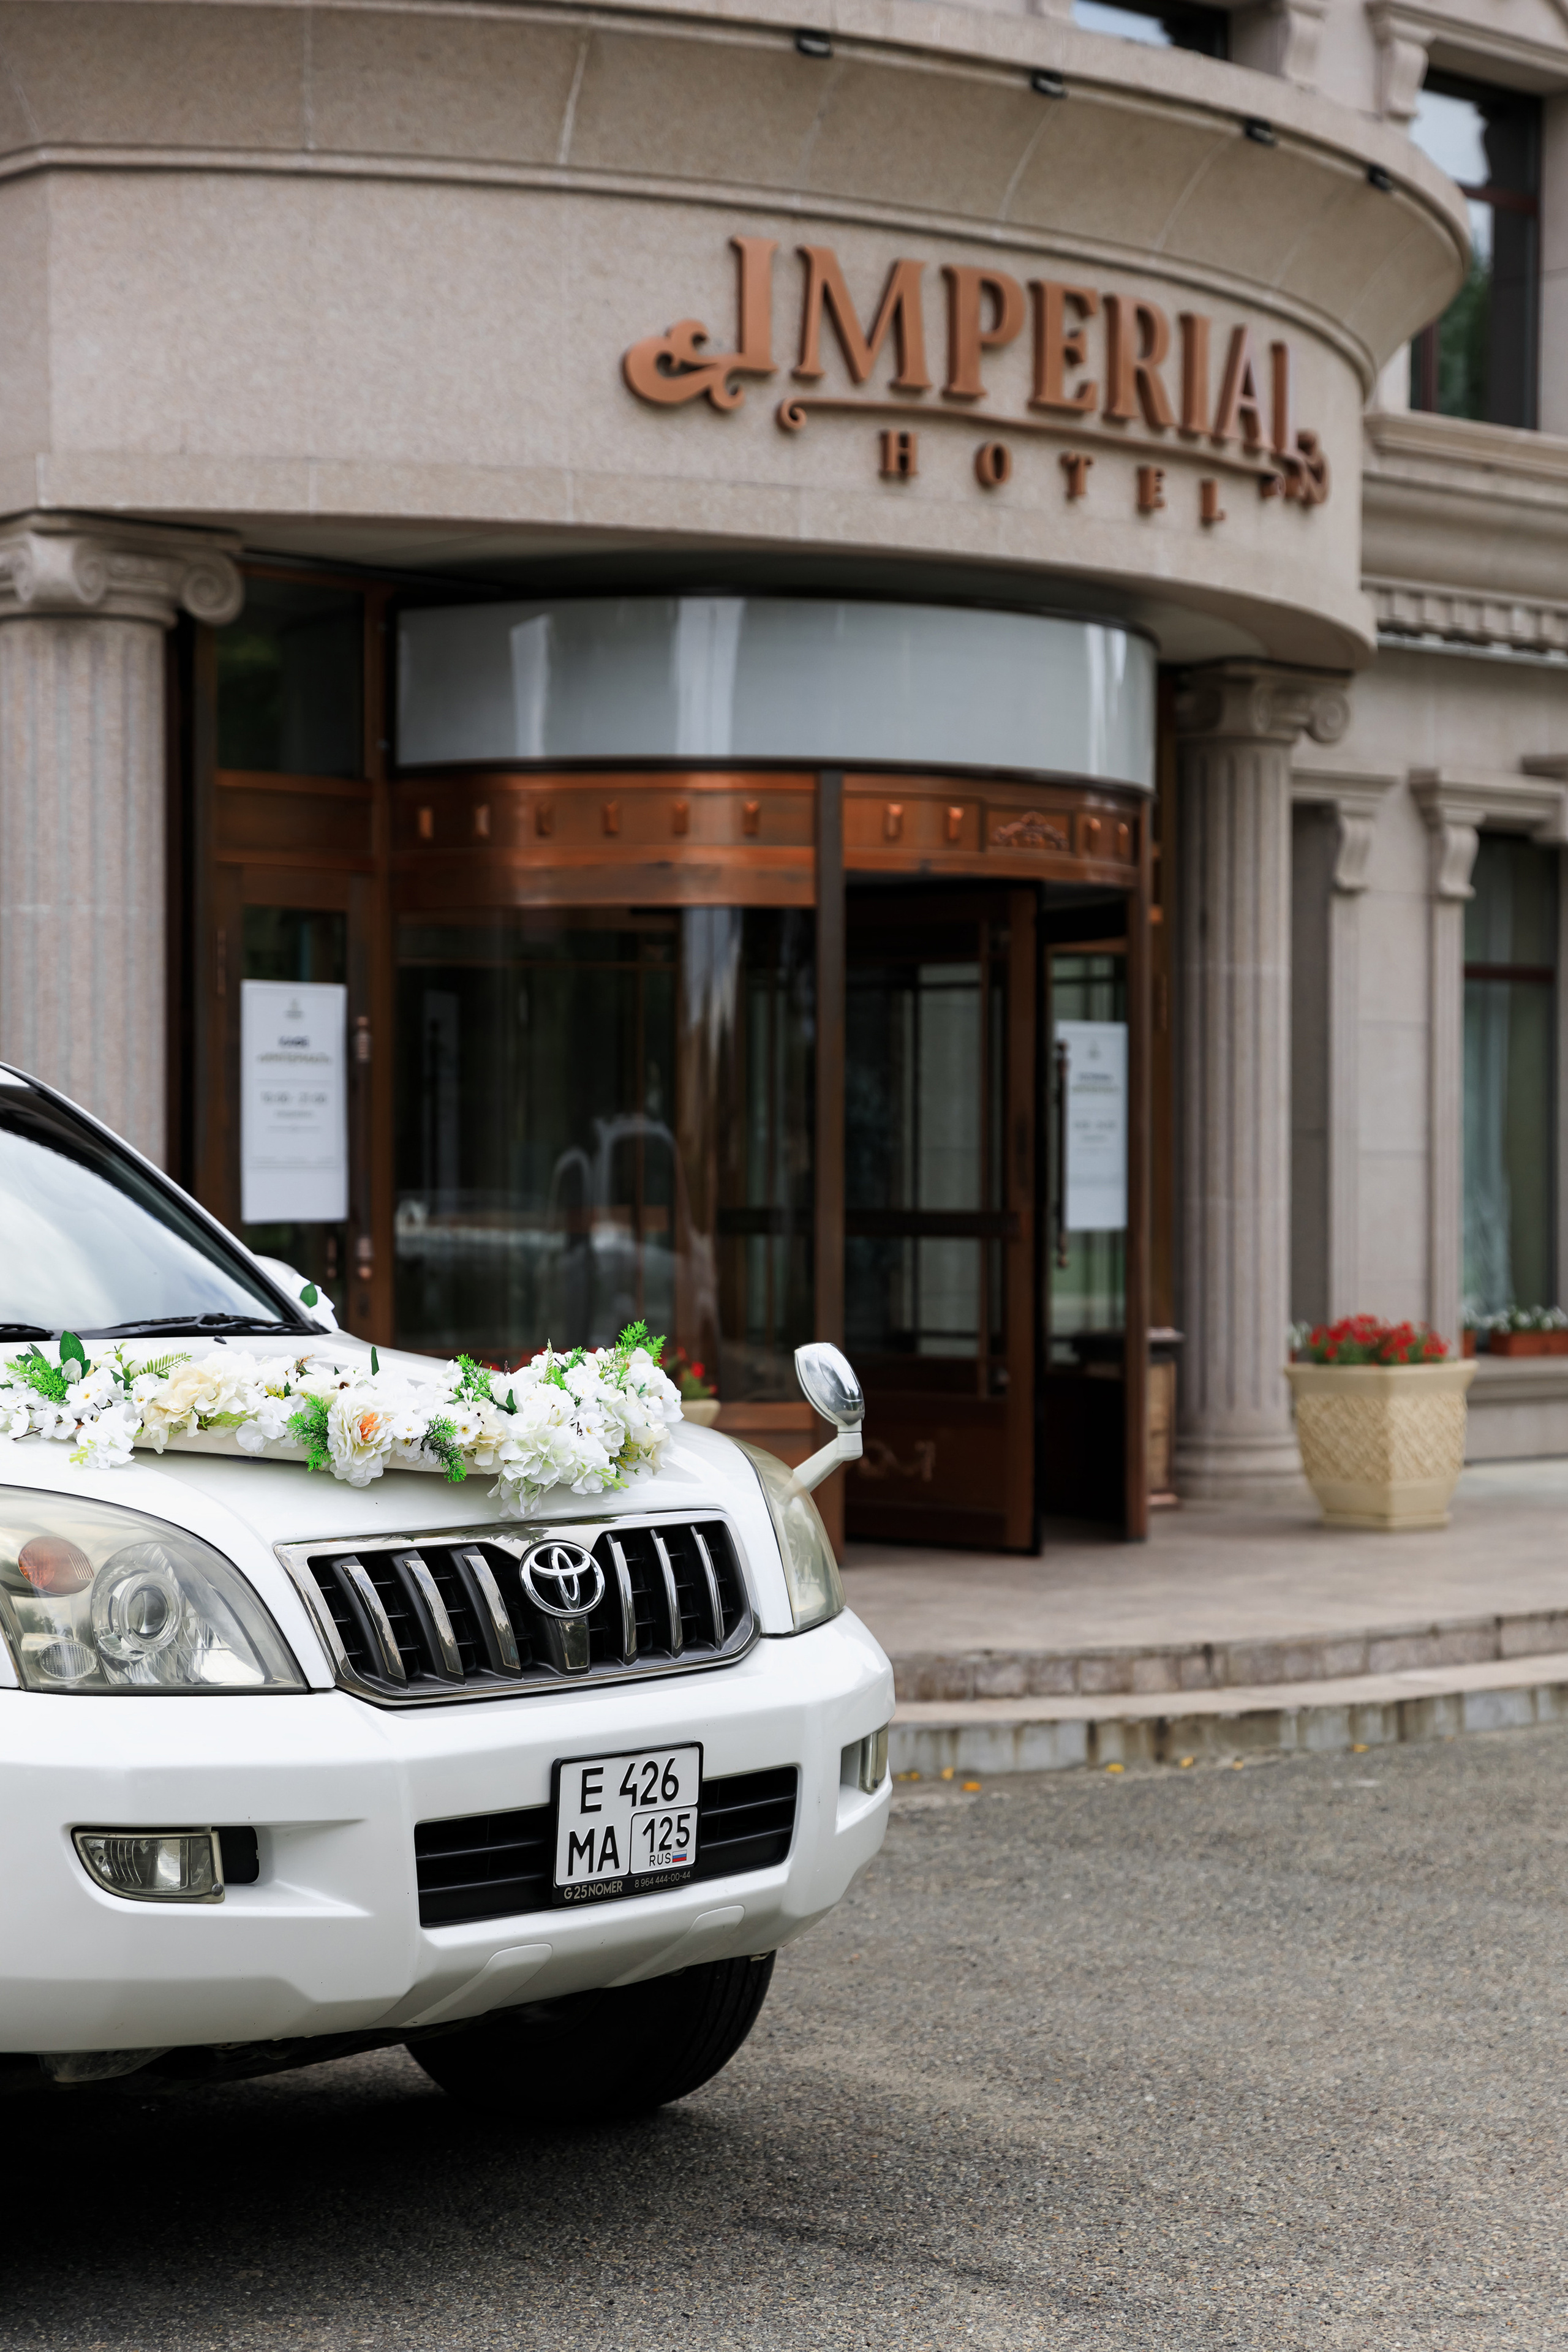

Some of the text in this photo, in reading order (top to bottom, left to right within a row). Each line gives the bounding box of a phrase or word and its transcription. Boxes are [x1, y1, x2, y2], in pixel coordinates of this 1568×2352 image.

[728, 235, 1317, 459] IMPERIAL
[878, 430, 1225, 527] HOTEL
[580, 1757, 679, 1814] E 426
[567, 1825, 620, 1876] MA
[643, 1813, 690, 1853] 125
[635, 1879, 639, 1888] 8
[641, 1877, 654, 1887] 964
[655, 1871, 691, 1884] 444-00-44
[649, 1852, 671, 1866] RUS
